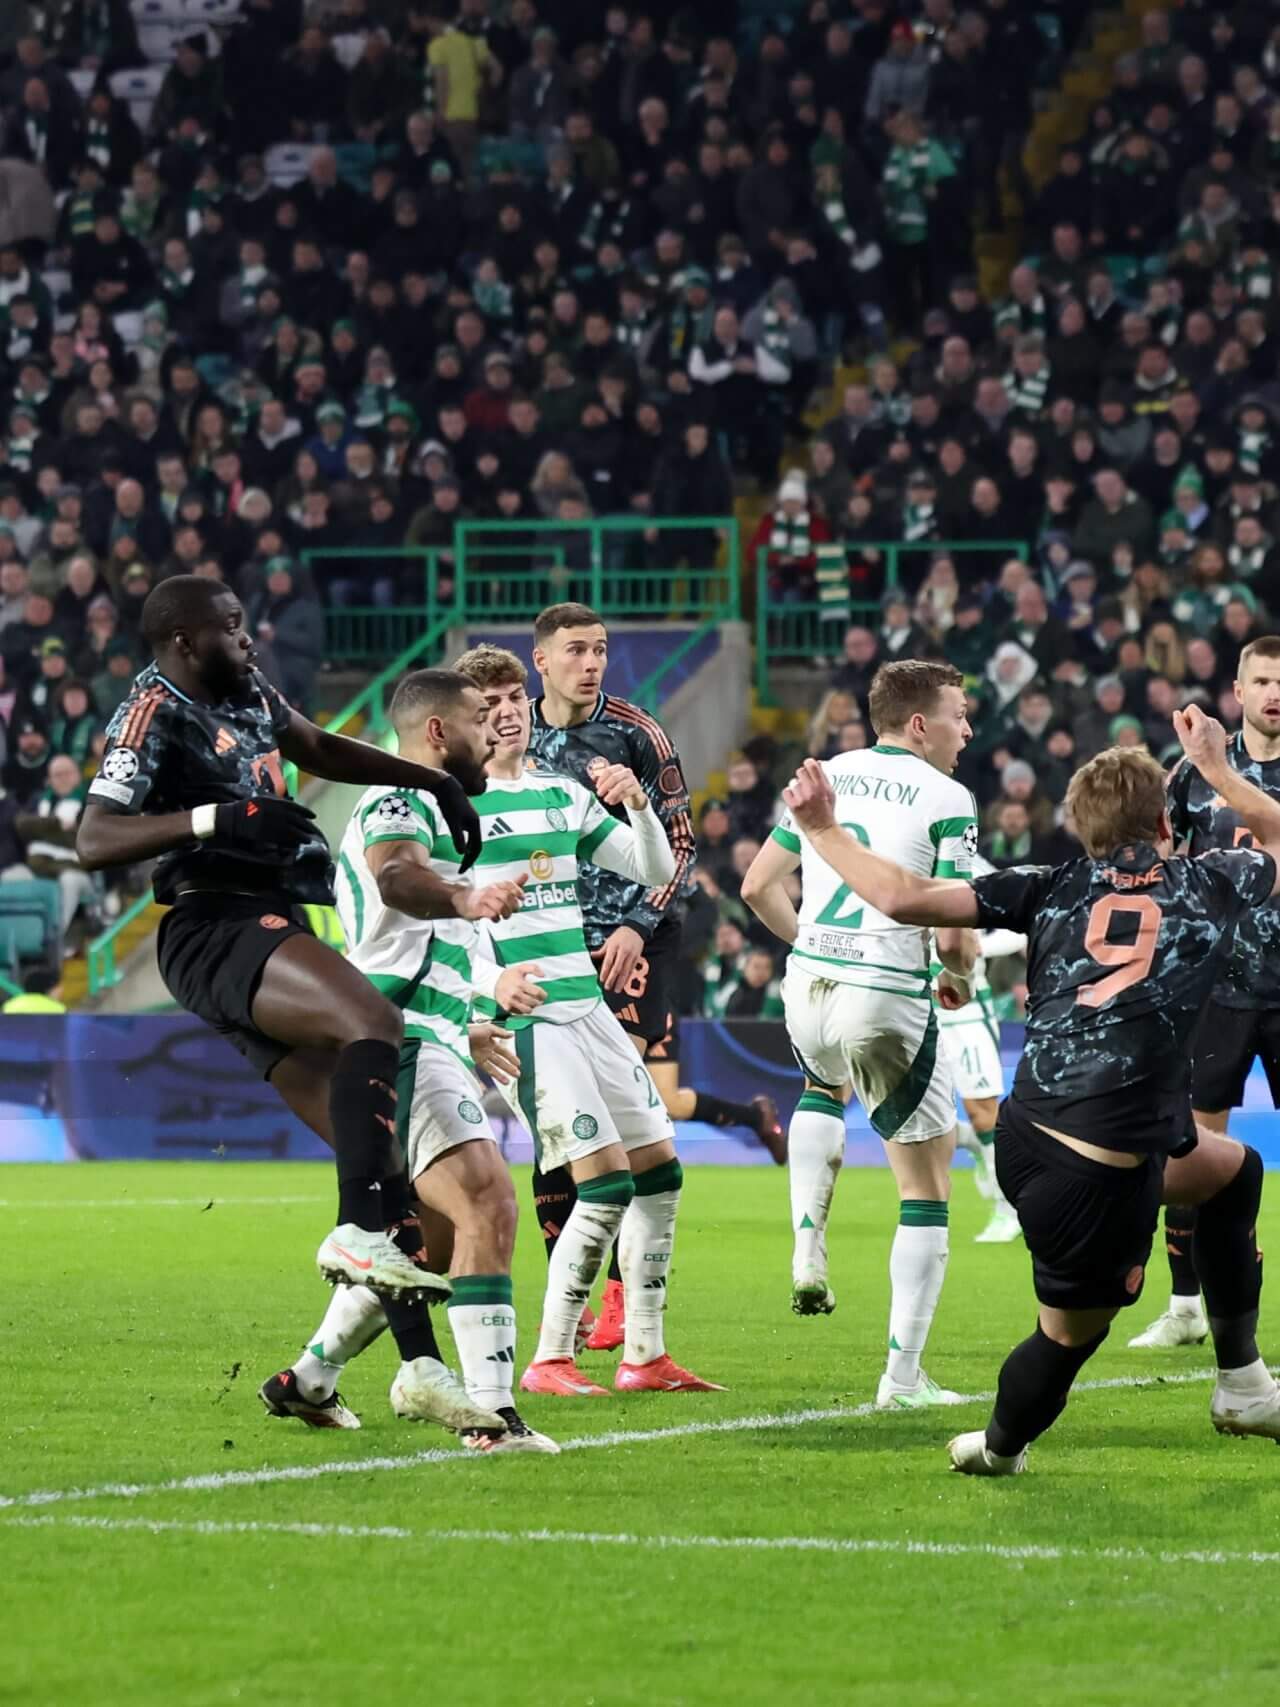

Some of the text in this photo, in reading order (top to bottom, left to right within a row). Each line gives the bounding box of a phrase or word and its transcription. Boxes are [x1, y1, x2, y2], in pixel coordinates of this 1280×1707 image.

[815, 823, 872, 928] 2
[520, 883, 577, 909] afabet
[819, 945, 864, 960] FOUNDATION
[821, 933, 855, 947] CELTIC FC
[1084, 893, 1162, 1008] 9
